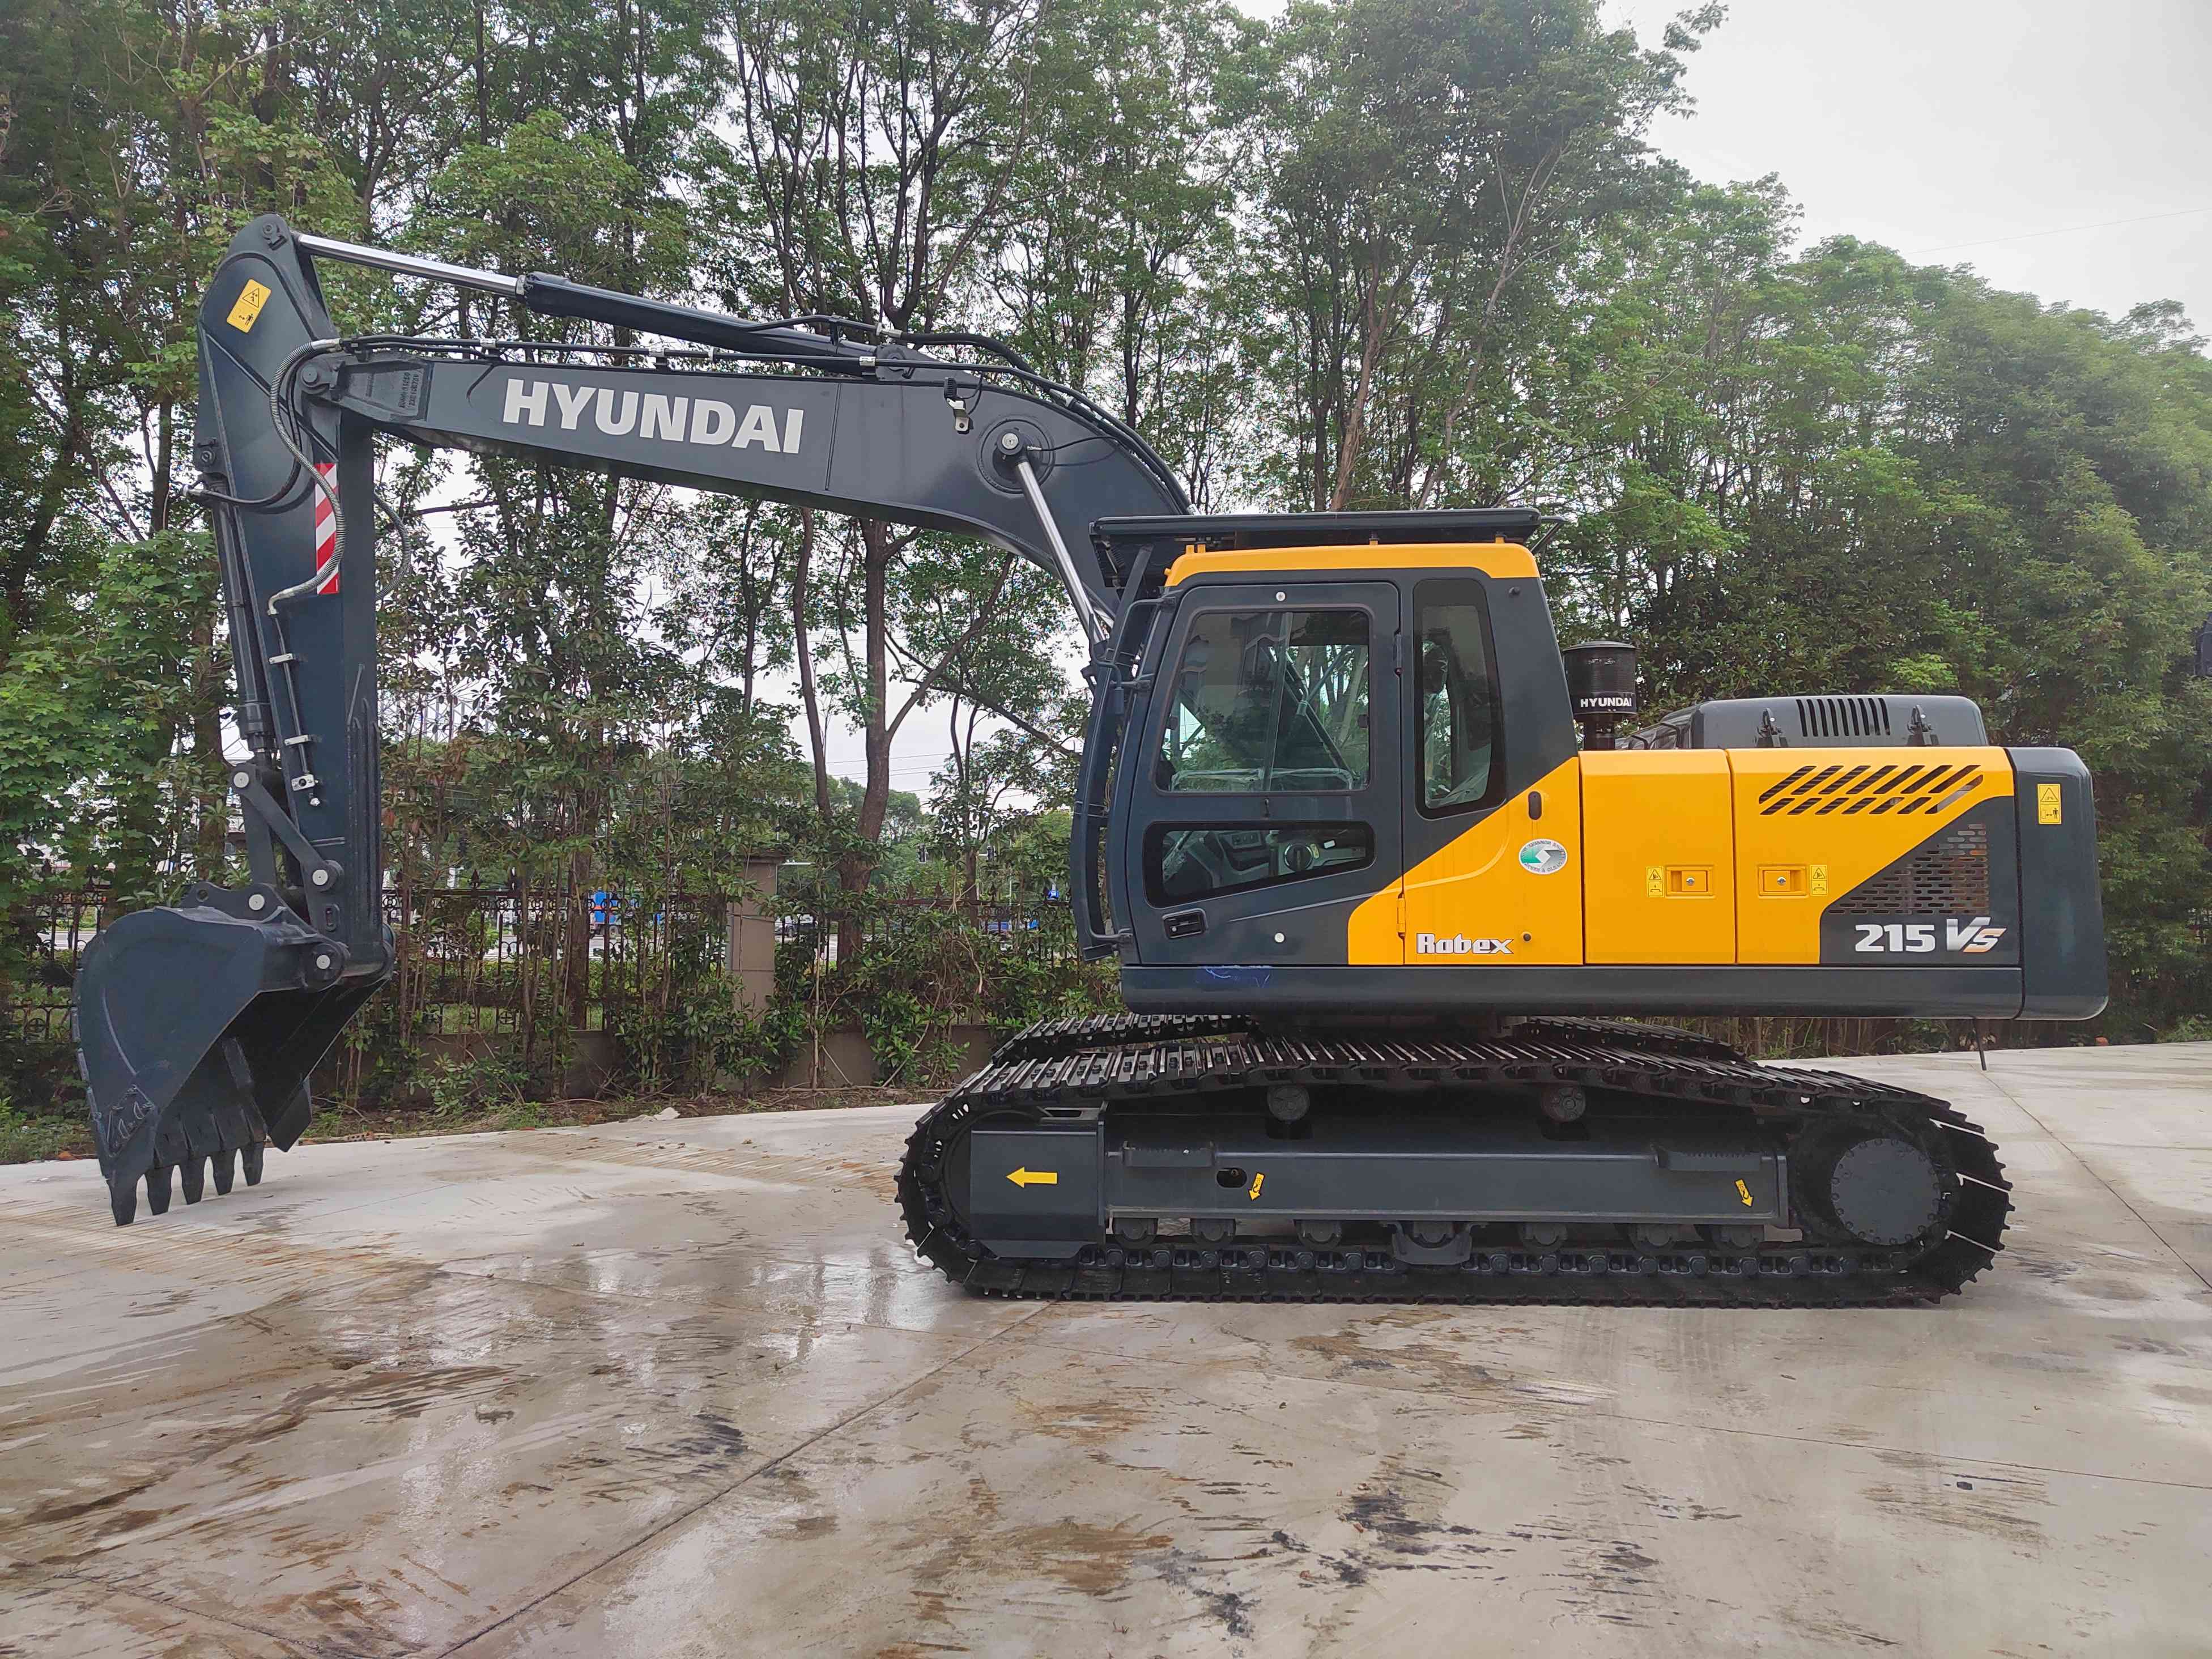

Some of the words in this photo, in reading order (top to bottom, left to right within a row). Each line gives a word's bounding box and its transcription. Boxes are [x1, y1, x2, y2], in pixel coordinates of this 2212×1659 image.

[503, 378, 804, 454] HYUNDAI
[1580, 697, 1632, 708] HYUNDAI
[1416, 933, 1515, 954] Robex
[1854, 924, 1936, 952] 215
